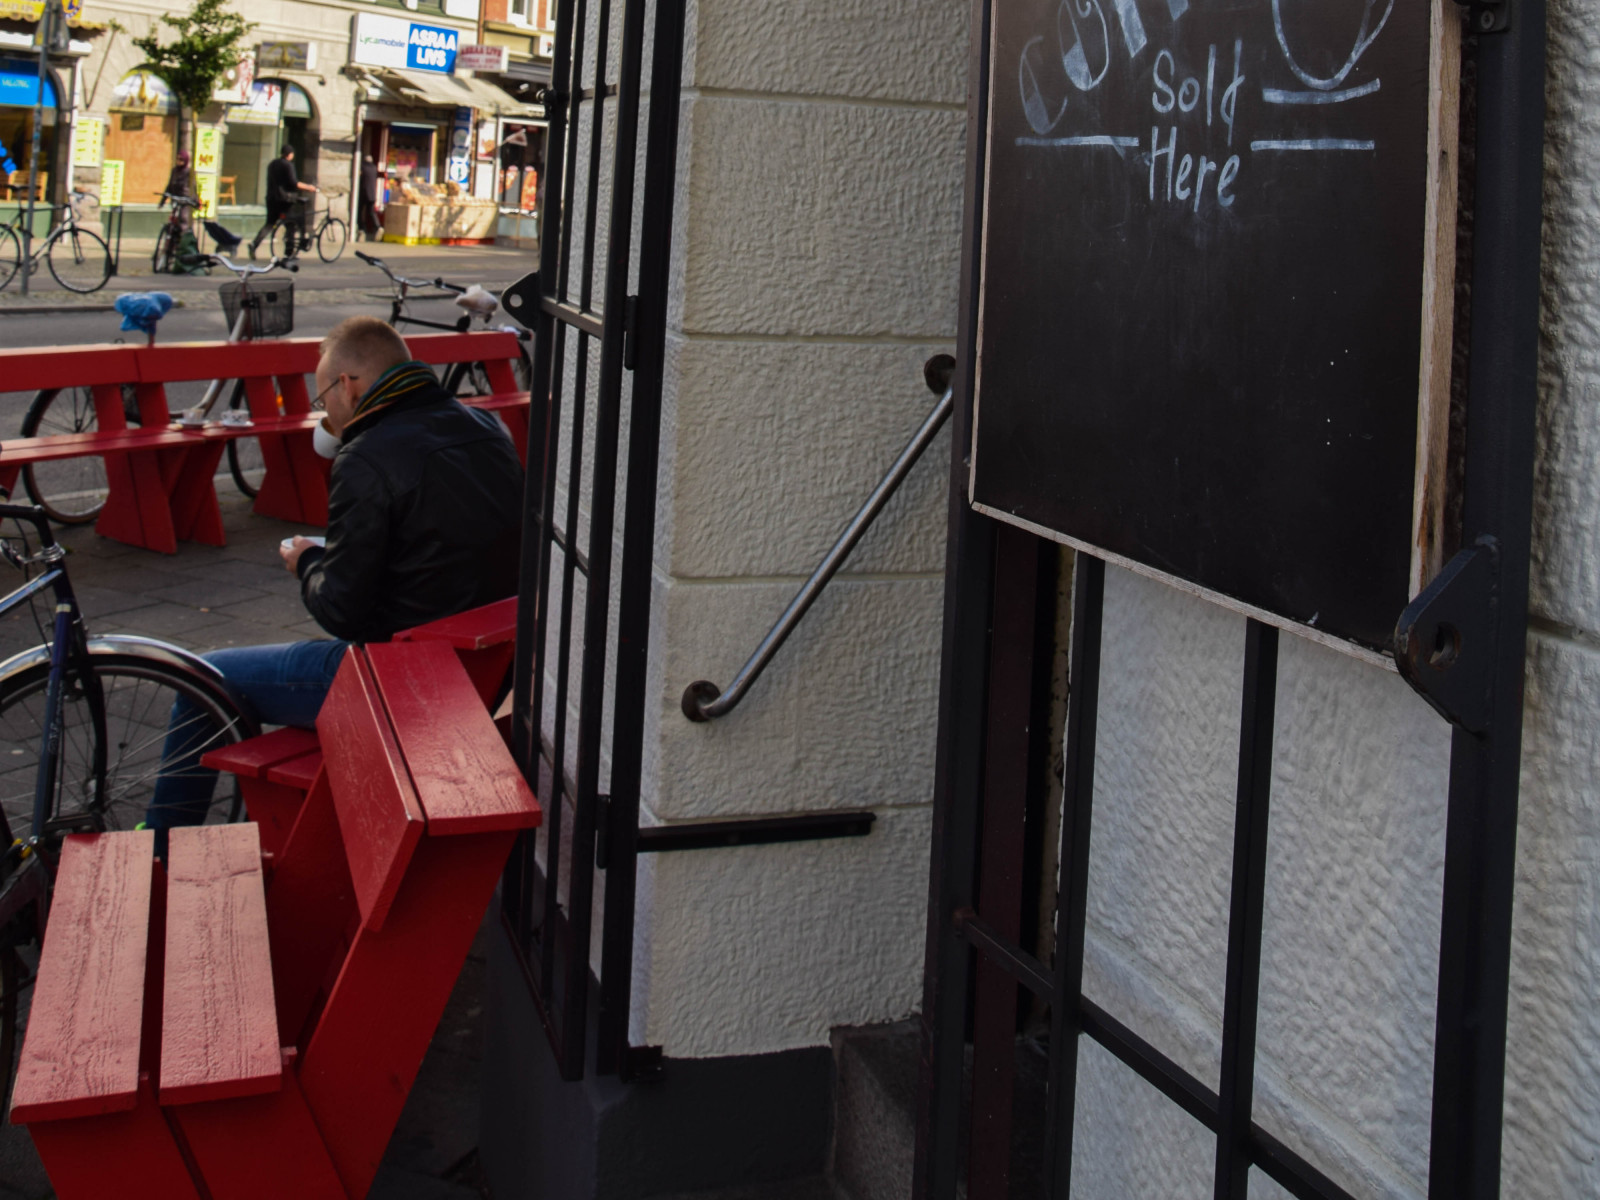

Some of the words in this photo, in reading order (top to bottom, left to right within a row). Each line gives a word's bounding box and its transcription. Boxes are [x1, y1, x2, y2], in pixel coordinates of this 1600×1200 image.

[409, 28, 457, 52] ASRAA
[416, 46, 447, 68] LIVS
[1152, 39, 1245, 146] Sold
[1149, 126, 1240, 213] Here
